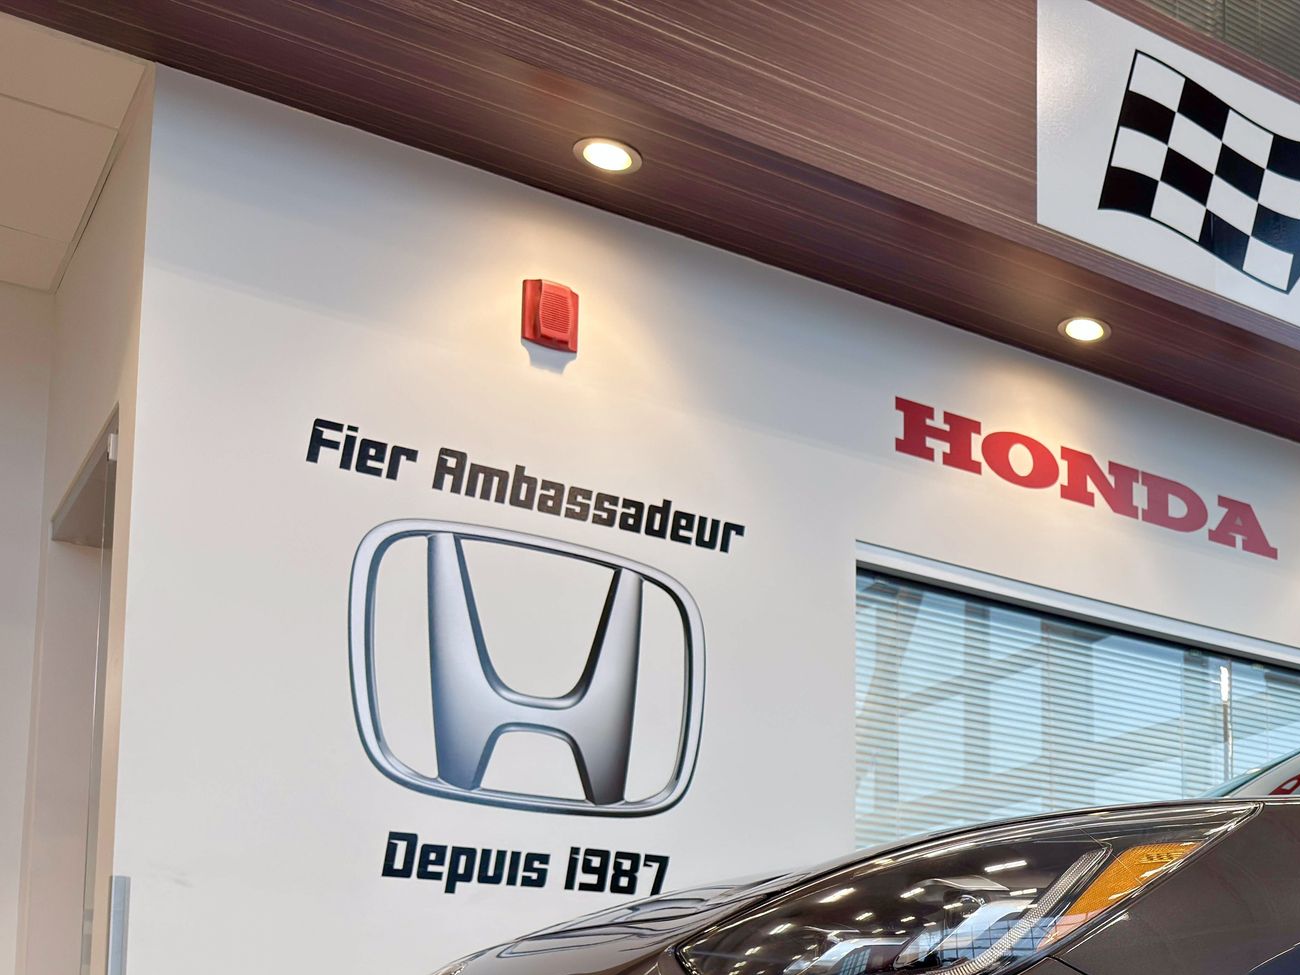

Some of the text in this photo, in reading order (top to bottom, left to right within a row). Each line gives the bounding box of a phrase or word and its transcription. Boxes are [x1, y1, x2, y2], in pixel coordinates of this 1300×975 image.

[305, 417, 746, 554] Fier Ambassadeur
[895, 396, 1278, 560] HONDA
[381, 830, 670, 897] Depuis 1987
